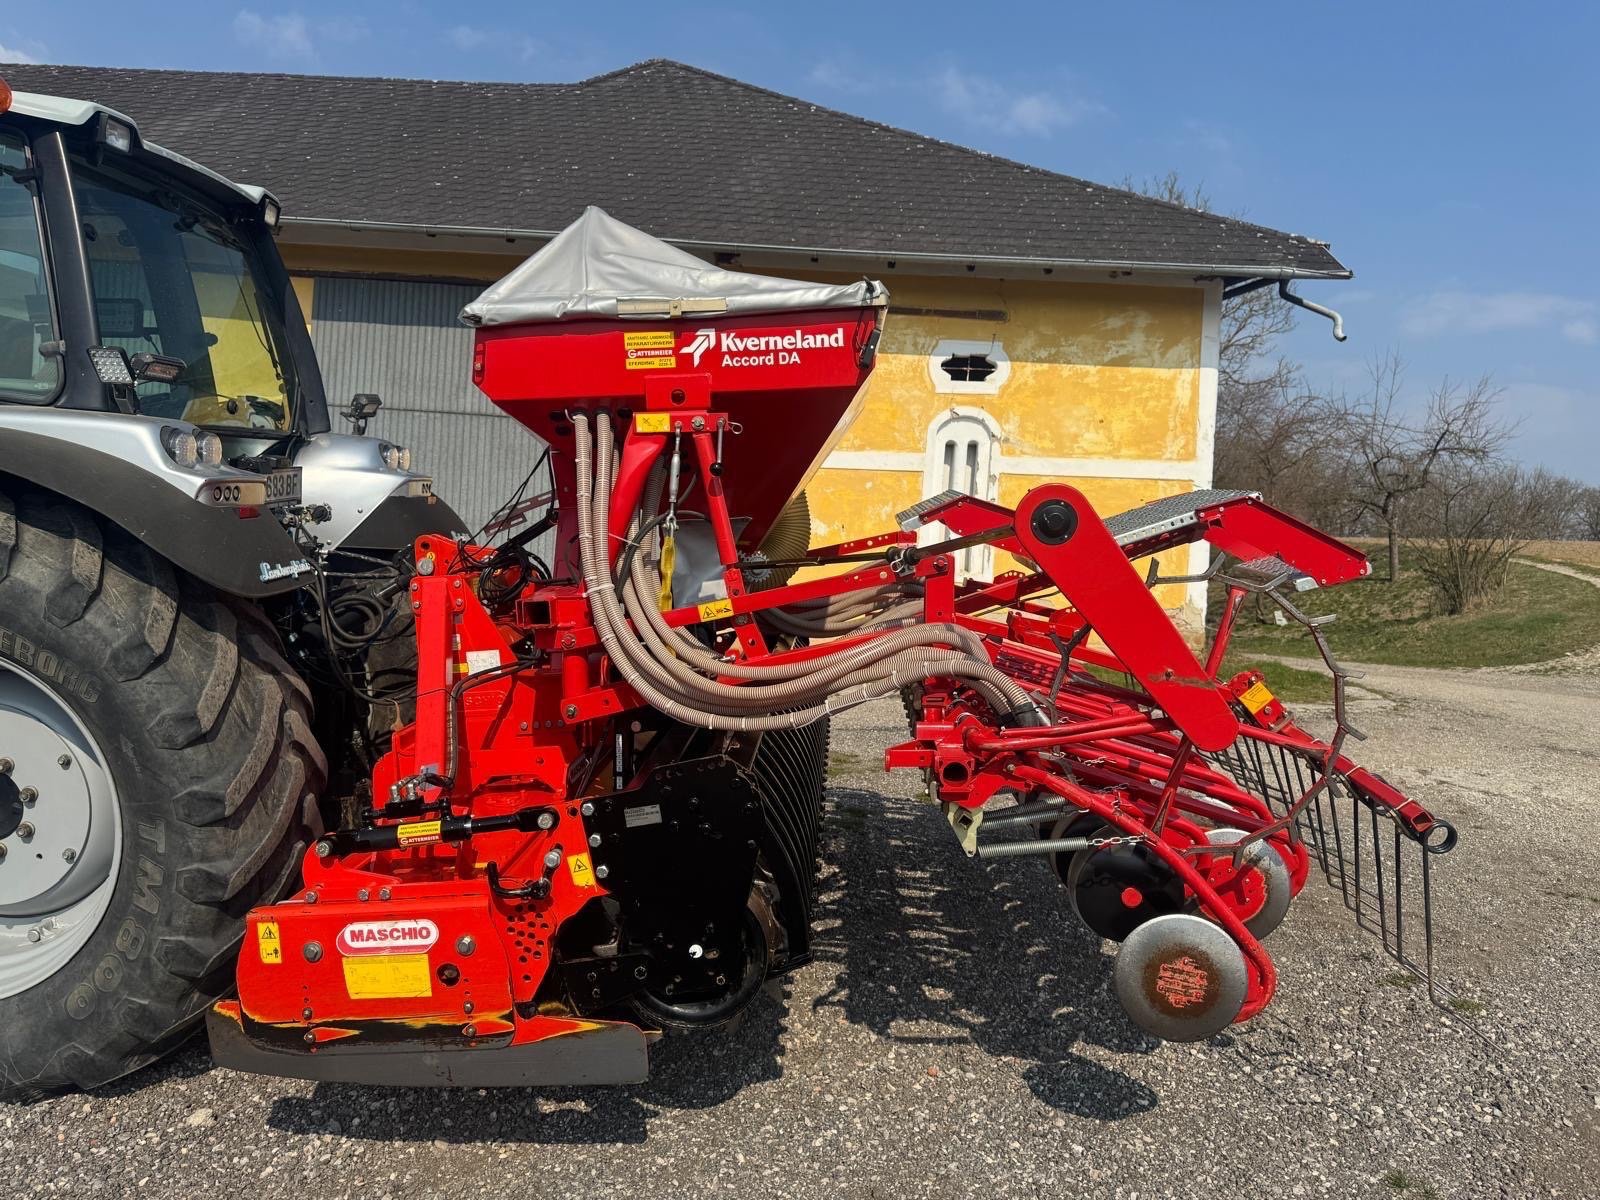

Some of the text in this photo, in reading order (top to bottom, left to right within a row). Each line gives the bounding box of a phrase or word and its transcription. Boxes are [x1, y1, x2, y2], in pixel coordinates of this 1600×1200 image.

[720, 328, 844, 352] Kverneland
[721, 352, 801, 367] Accord DA
[349, 927, 431, 943] MASCHIO
